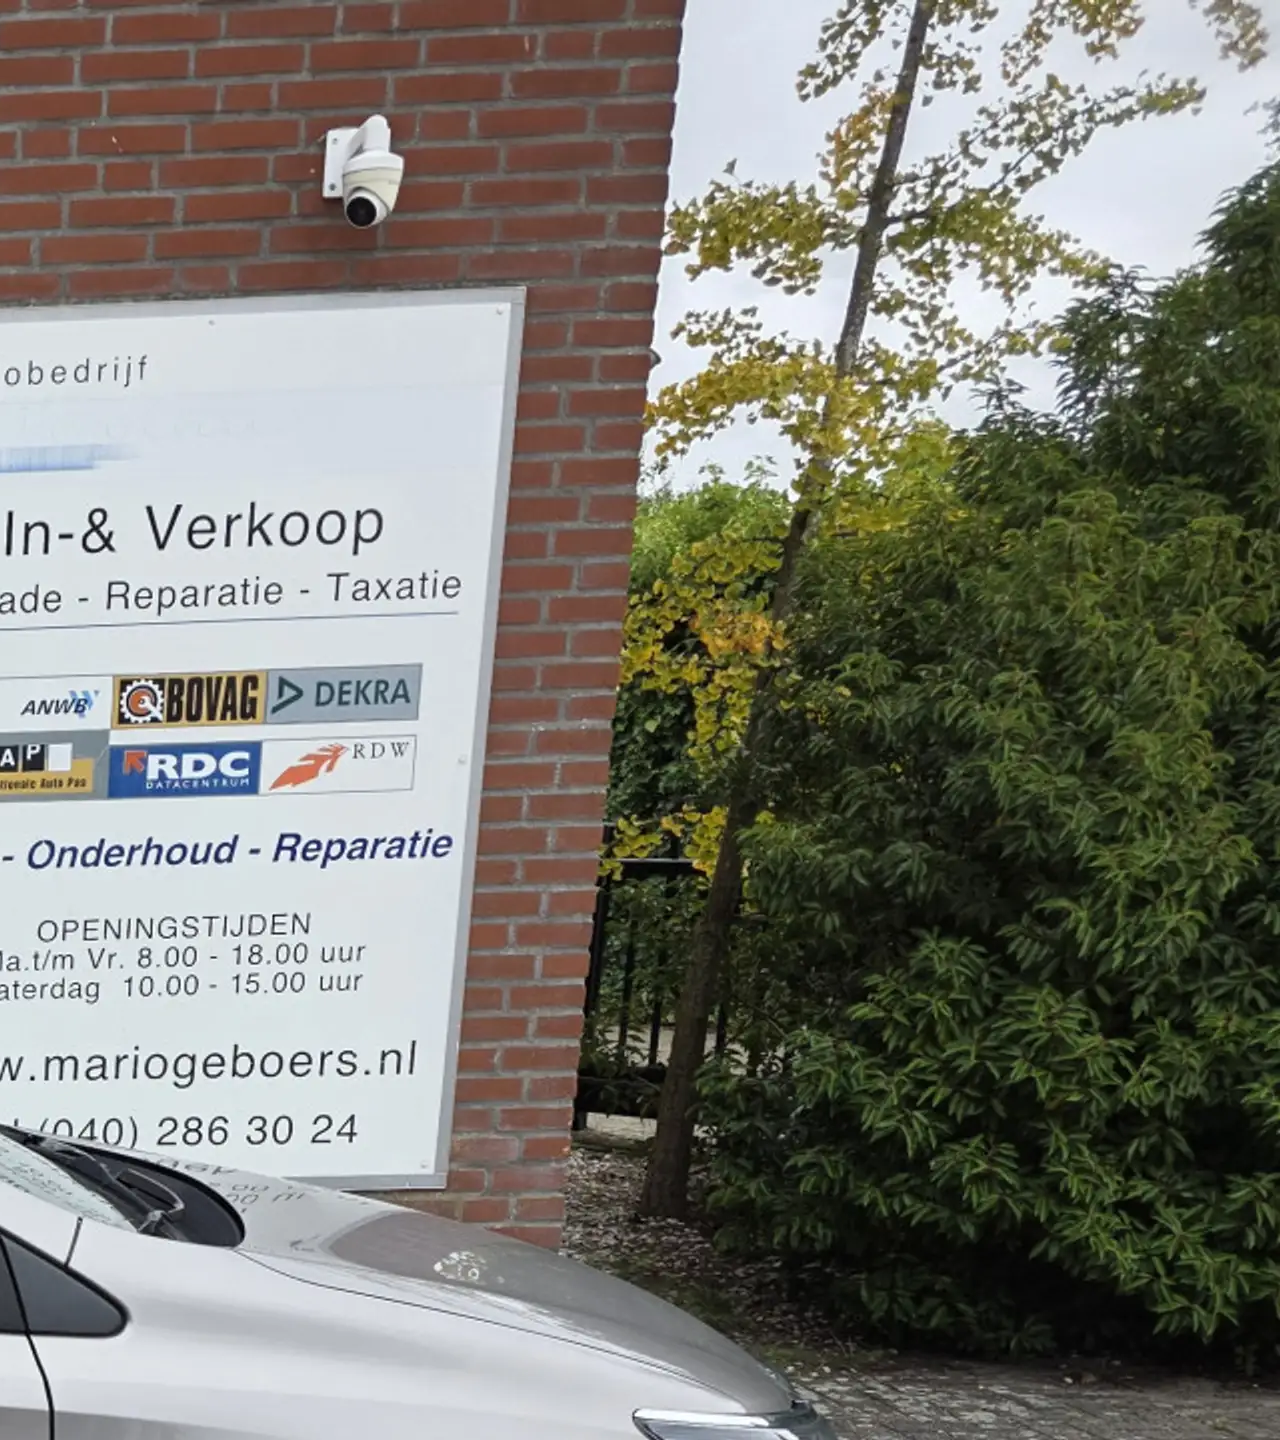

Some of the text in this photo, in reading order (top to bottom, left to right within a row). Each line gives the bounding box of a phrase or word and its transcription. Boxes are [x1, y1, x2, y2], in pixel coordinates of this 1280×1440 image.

[6, 502, 383, 556] In-& Verkoop
[106, 576, 284, 616] Reparatie
[327, 570, 461, 601] Taxatie
[166, 676, 258, 723] BOVAG
[315, 678, 411, 706] DEKRA
[20, 698, 88, 716] ANWB
[352, 740, 410, 758] RDW
[147, 752, 250, 778] RDC
[146, 778, 250, 790] DATACENTRUM
[28, 834, 239, 869] Onderhoud
[273, 828, 453, 867] Reparatie
[38, 913, 310, 943] OPENINGSTIJDEN
[88, 948, 123, 969] Vr.
[138, 946, 197, 969] 8.00
[233, 942, 308, 965] 18.00
[321, 946, 366, 963] uur
[124, 974, 199, 997] 10.00
[233, 972, 305, 994] 15.00
[320, 974, 363, 991] uur
[157, 1116, 228, 1146] 286
[246, 1115, 293, 1145] 30
[311, 1114, 357, 1143] 24
